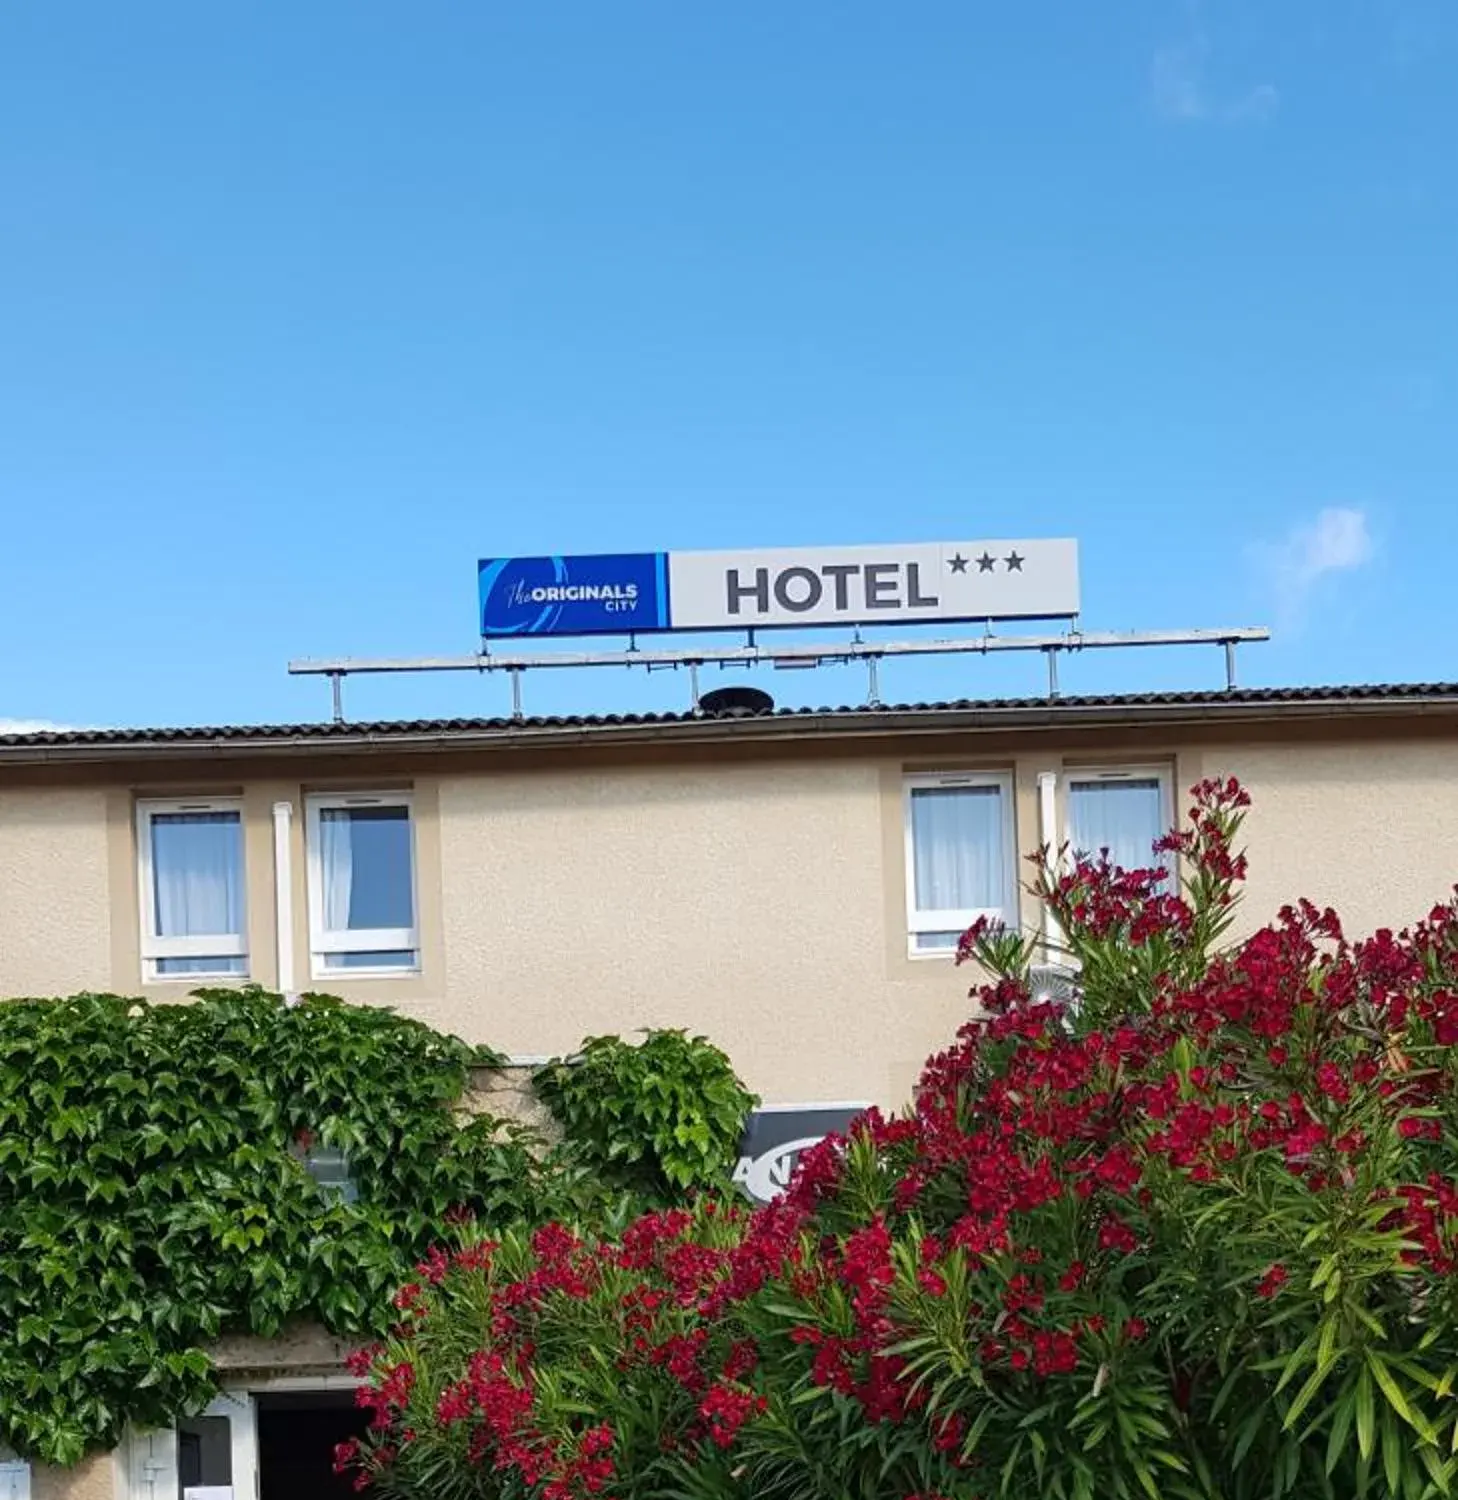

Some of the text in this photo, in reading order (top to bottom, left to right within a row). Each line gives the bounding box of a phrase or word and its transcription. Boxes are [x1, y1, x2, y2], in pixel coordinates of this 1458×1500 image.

[531, 584, 638, 602] ORIGINALS
[726, 562, 939, 615] HOTEL
[605, 600, 638, 612] CITY
